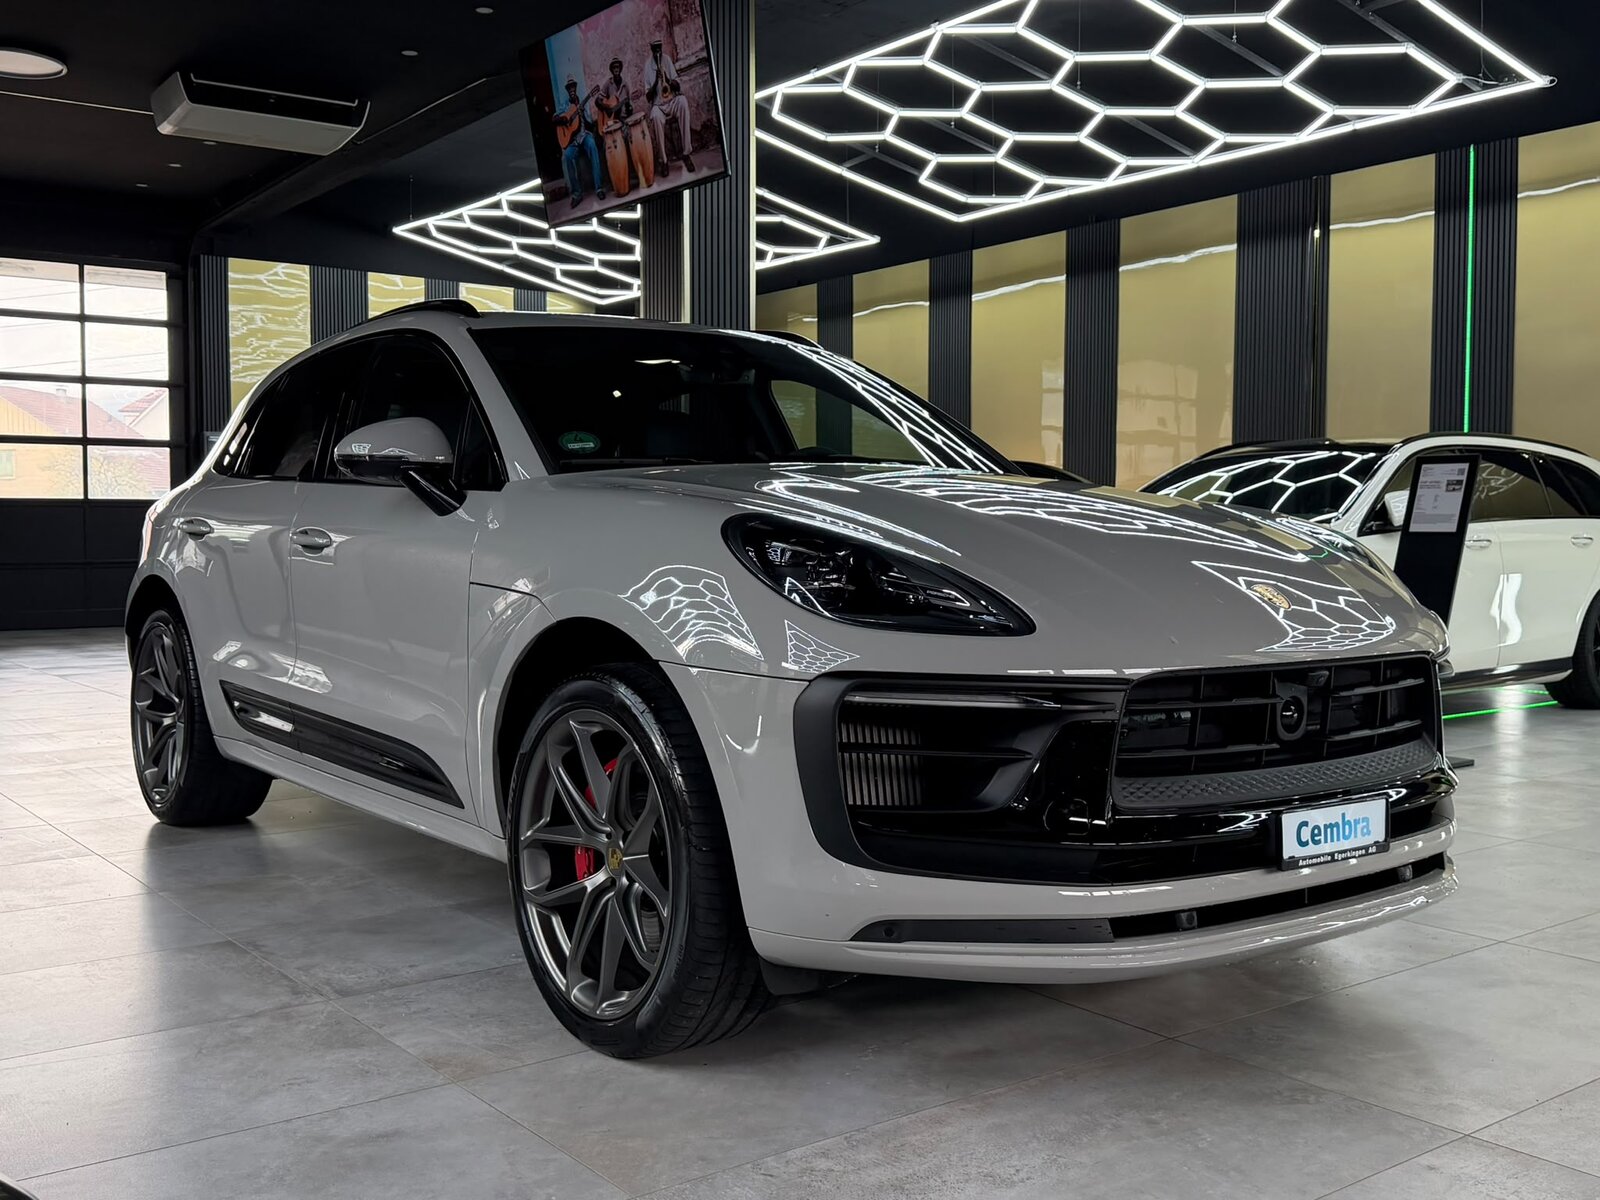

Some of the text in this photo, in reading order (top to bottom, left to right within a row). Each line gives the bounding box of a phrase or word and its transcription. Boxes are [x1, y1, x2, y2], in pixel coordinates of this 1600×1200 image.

[1296, 812, 1371, 848] Cembra
[1298, 855, 1332, 866] Automobile
[1334, 848, 1366, 860] Egerkingen
